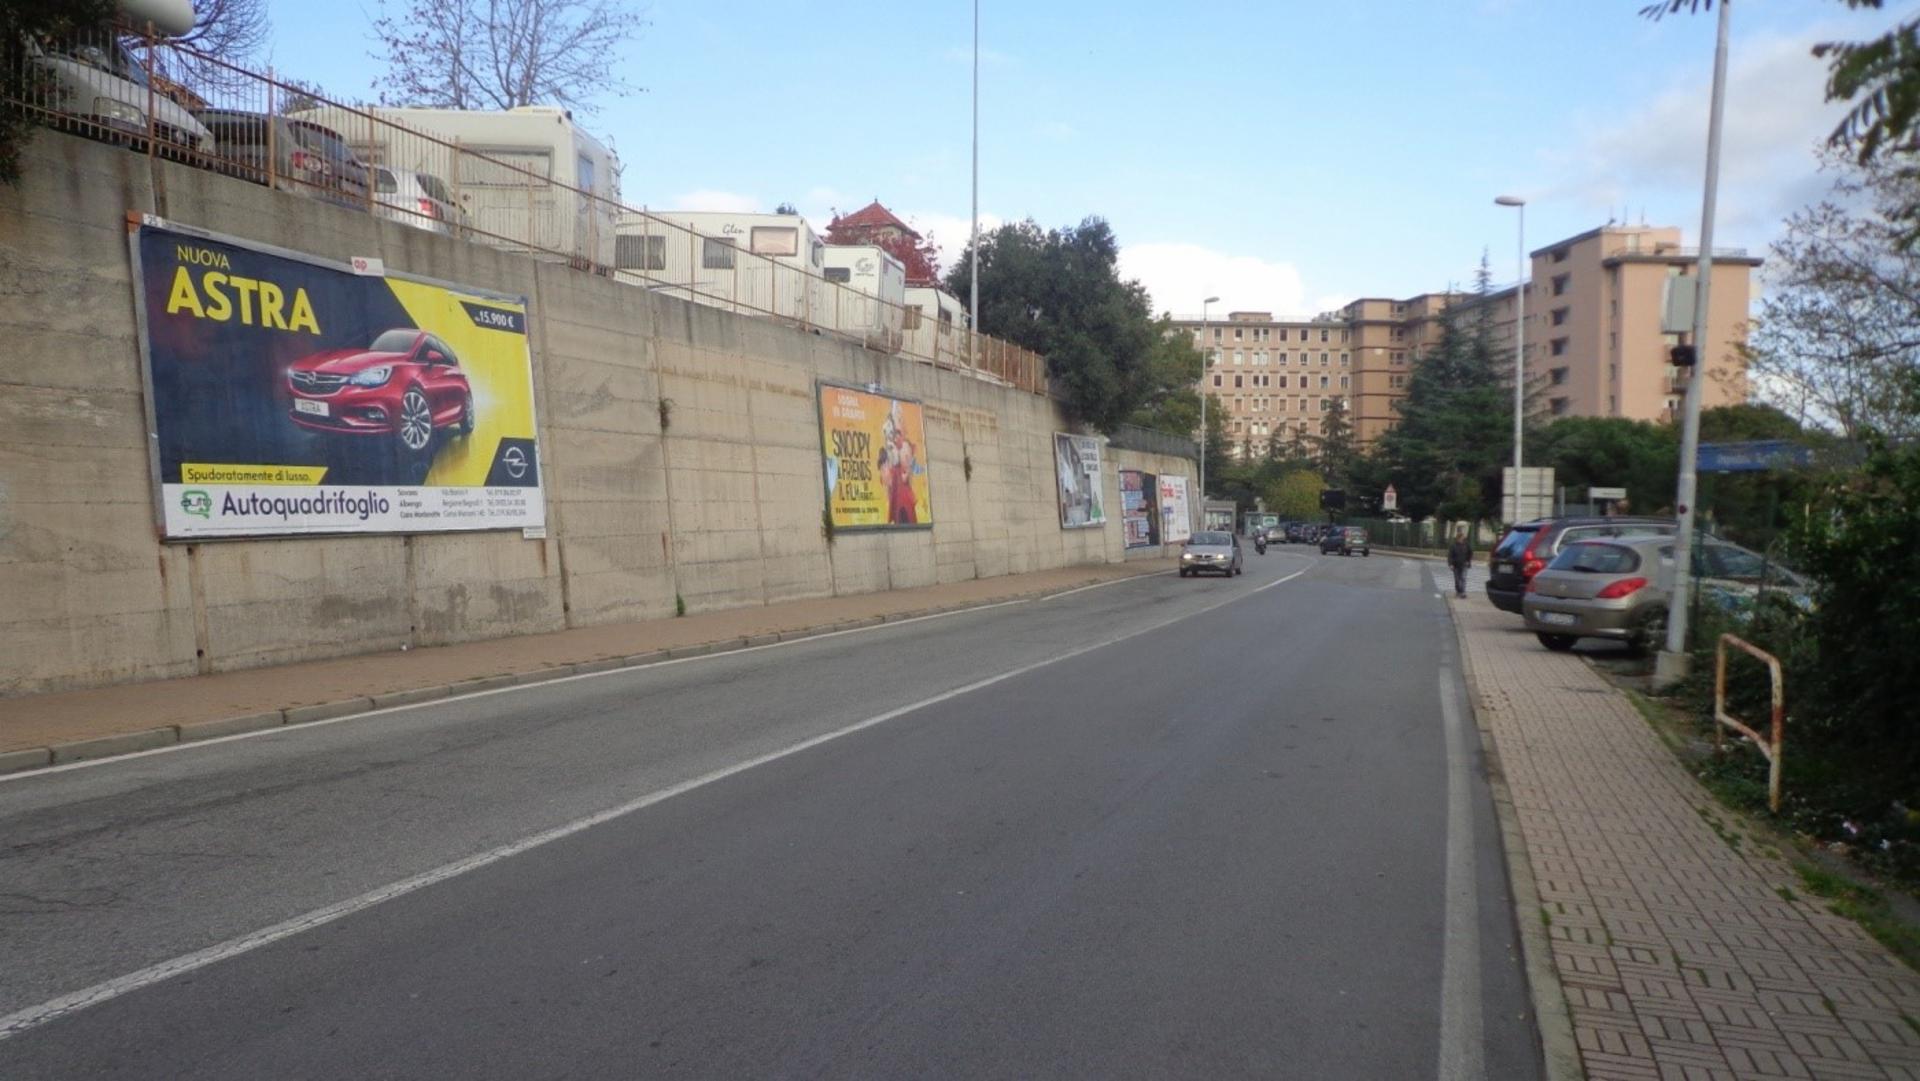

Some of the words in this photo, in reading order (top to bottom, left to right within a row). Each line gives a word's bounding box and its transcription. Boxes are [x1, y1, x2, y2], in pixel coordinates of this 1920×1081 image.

[177, 244, 231, 270] NUOVA
[166, 265, 321, 335] ASTRA
[480, 310, 507, 327] 15.900
[832, 428, 871, 459] SNOOPY
[188, 469, 273, 482] Spudoratamente
[276, 469, 284, 481] di
[285, 470, 312, 481] lusso.
[221, 490, 390, 521] Autoquadrifoglio
